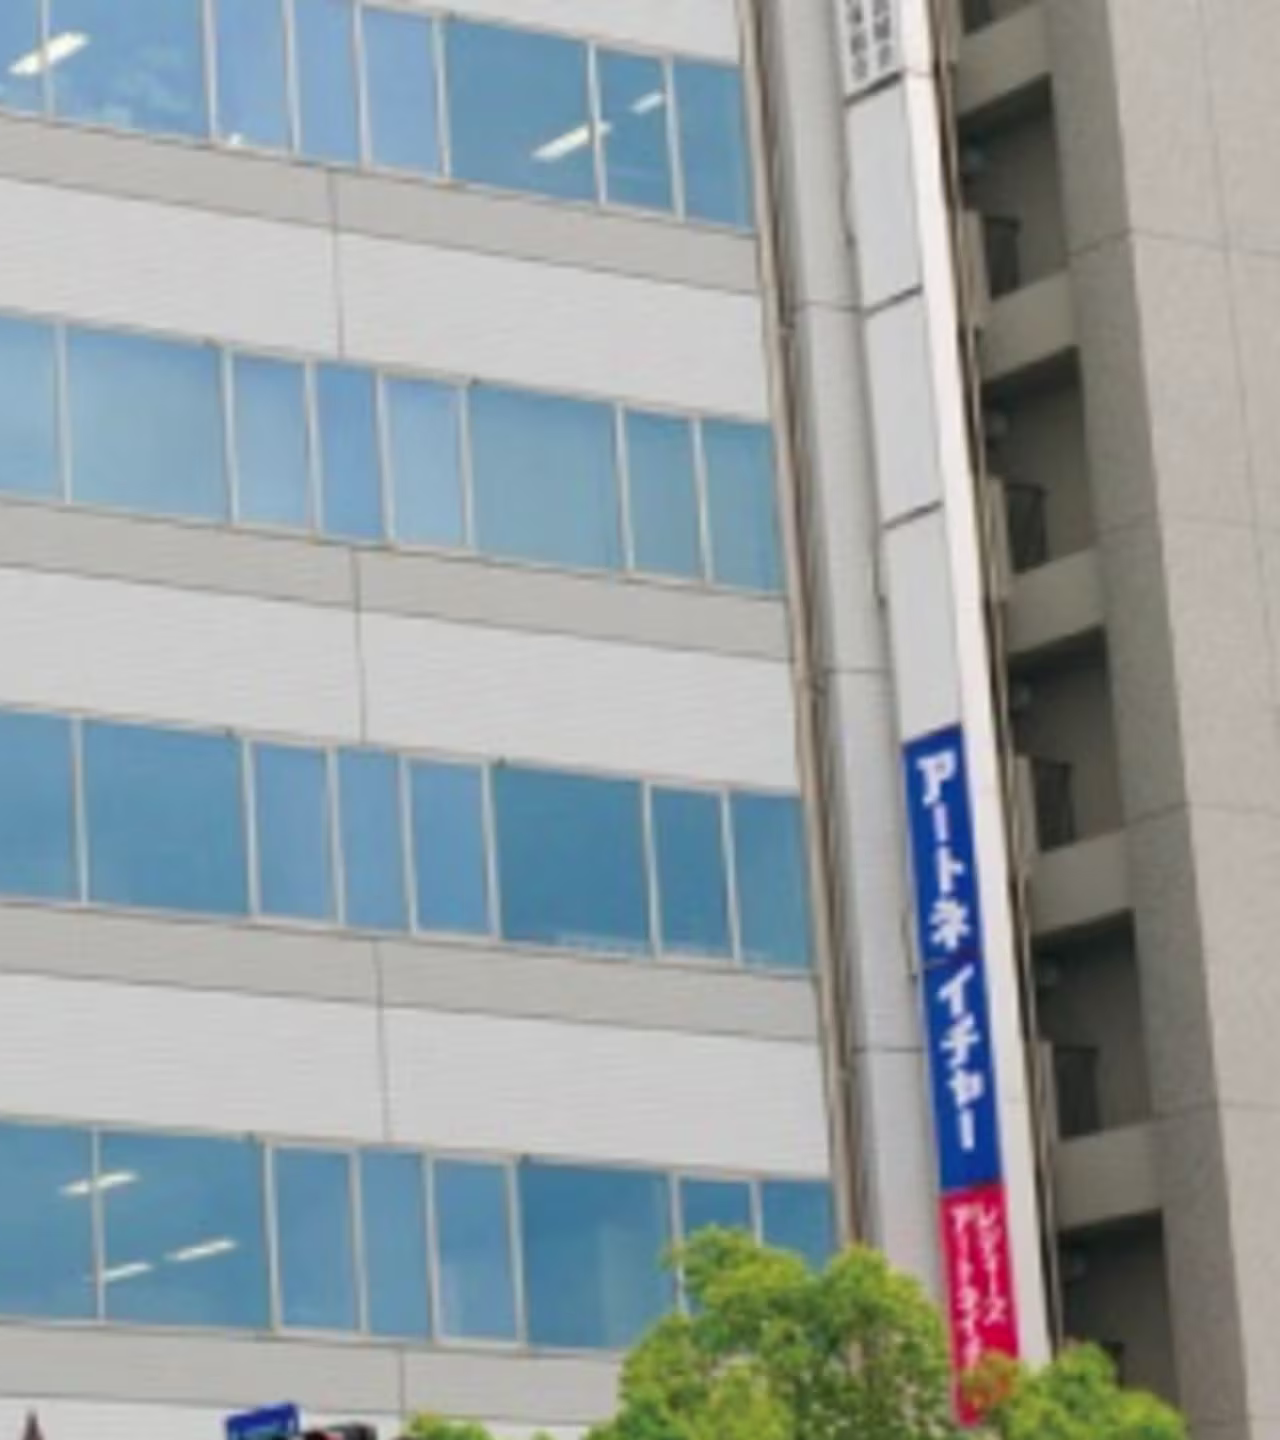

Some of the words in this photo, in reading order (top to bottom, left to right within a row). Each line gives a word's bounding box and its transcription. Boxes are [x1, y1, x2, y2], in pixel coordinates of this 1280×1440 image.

[916, 750, 985, 1152] アートネイチャー
